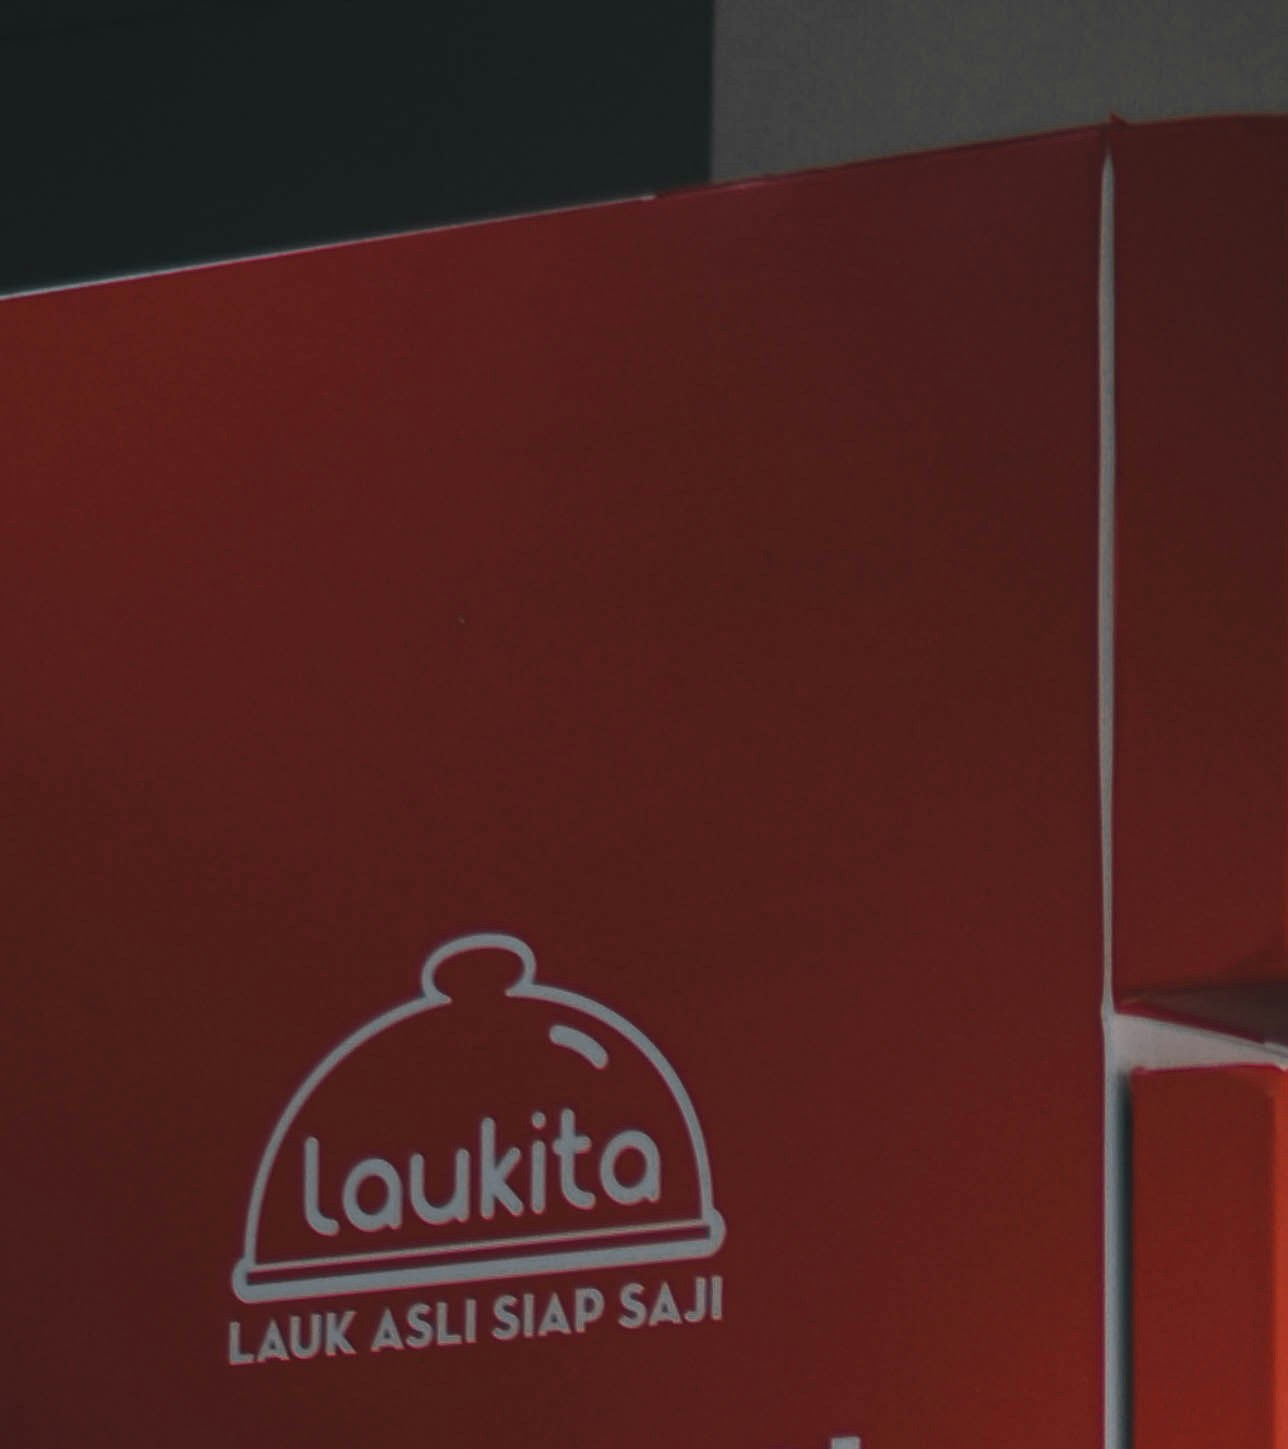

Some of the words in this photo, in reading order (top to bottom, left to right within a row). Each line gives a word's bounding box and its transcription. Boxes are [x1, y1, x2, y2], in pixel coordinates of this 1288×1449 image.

[228, 1307, 358, 1366] LAUK
[370, 1292, 478, 1355] ASLI
[491, 1287, 605, 1342] SIAP
[619, 1275, 725, 1328] SAJI
